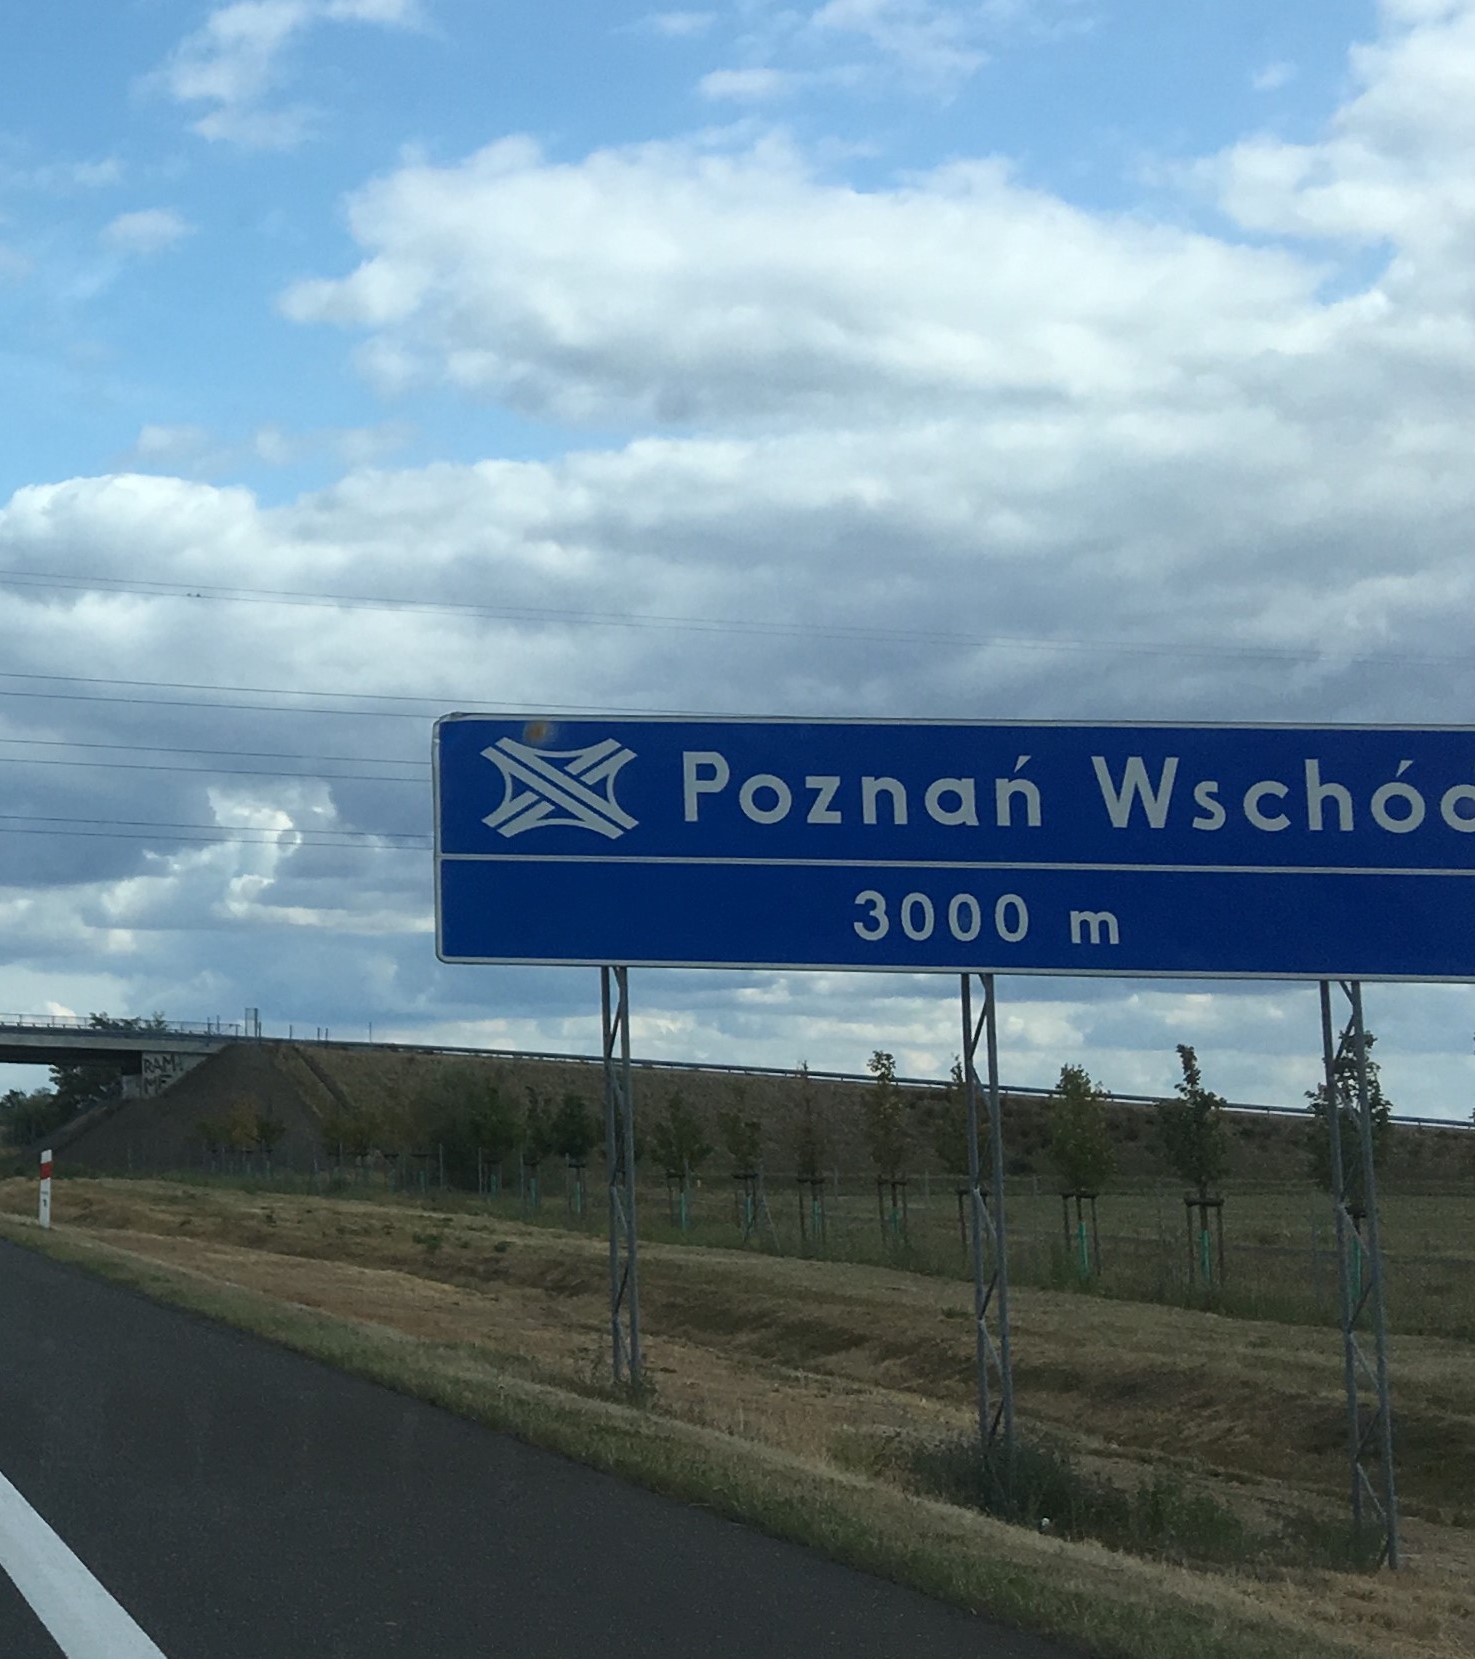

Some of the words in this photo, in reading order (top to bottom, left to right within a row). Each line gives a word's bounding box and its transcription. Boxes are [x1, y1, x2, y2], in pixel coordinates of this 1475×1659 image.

[682, 750, 1042, 827] Poznań
[853, 889, 1029, 942] 3000
[1069, 909, 1120, 945] m
